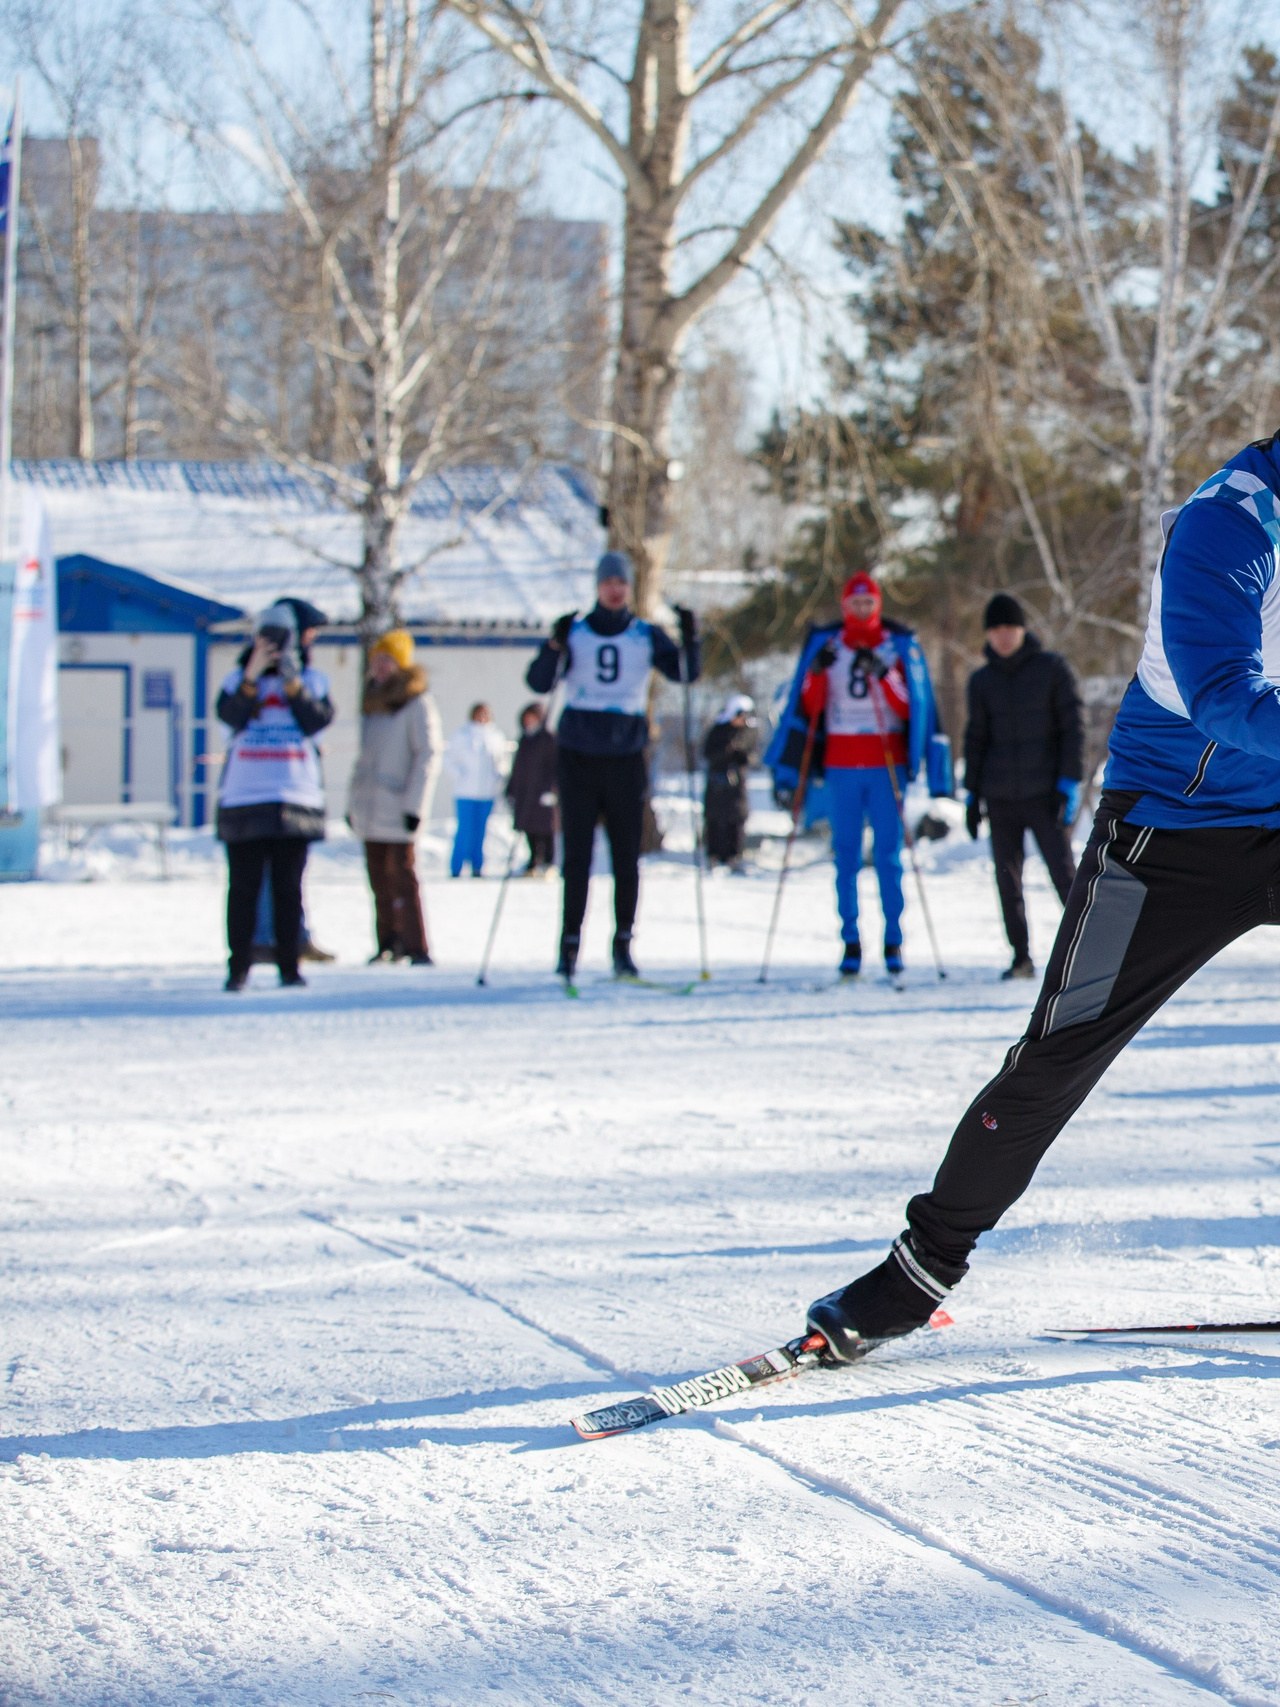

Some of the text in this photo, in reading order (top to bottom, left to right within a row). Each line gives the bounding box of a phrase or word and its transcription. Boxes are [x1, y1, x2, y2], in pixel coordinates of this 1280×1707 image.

[597, 644, 619, 684] 9
[849, 651, 869, 699] 8
[645, 1364, 751, 1416] ROSSIGNOL
